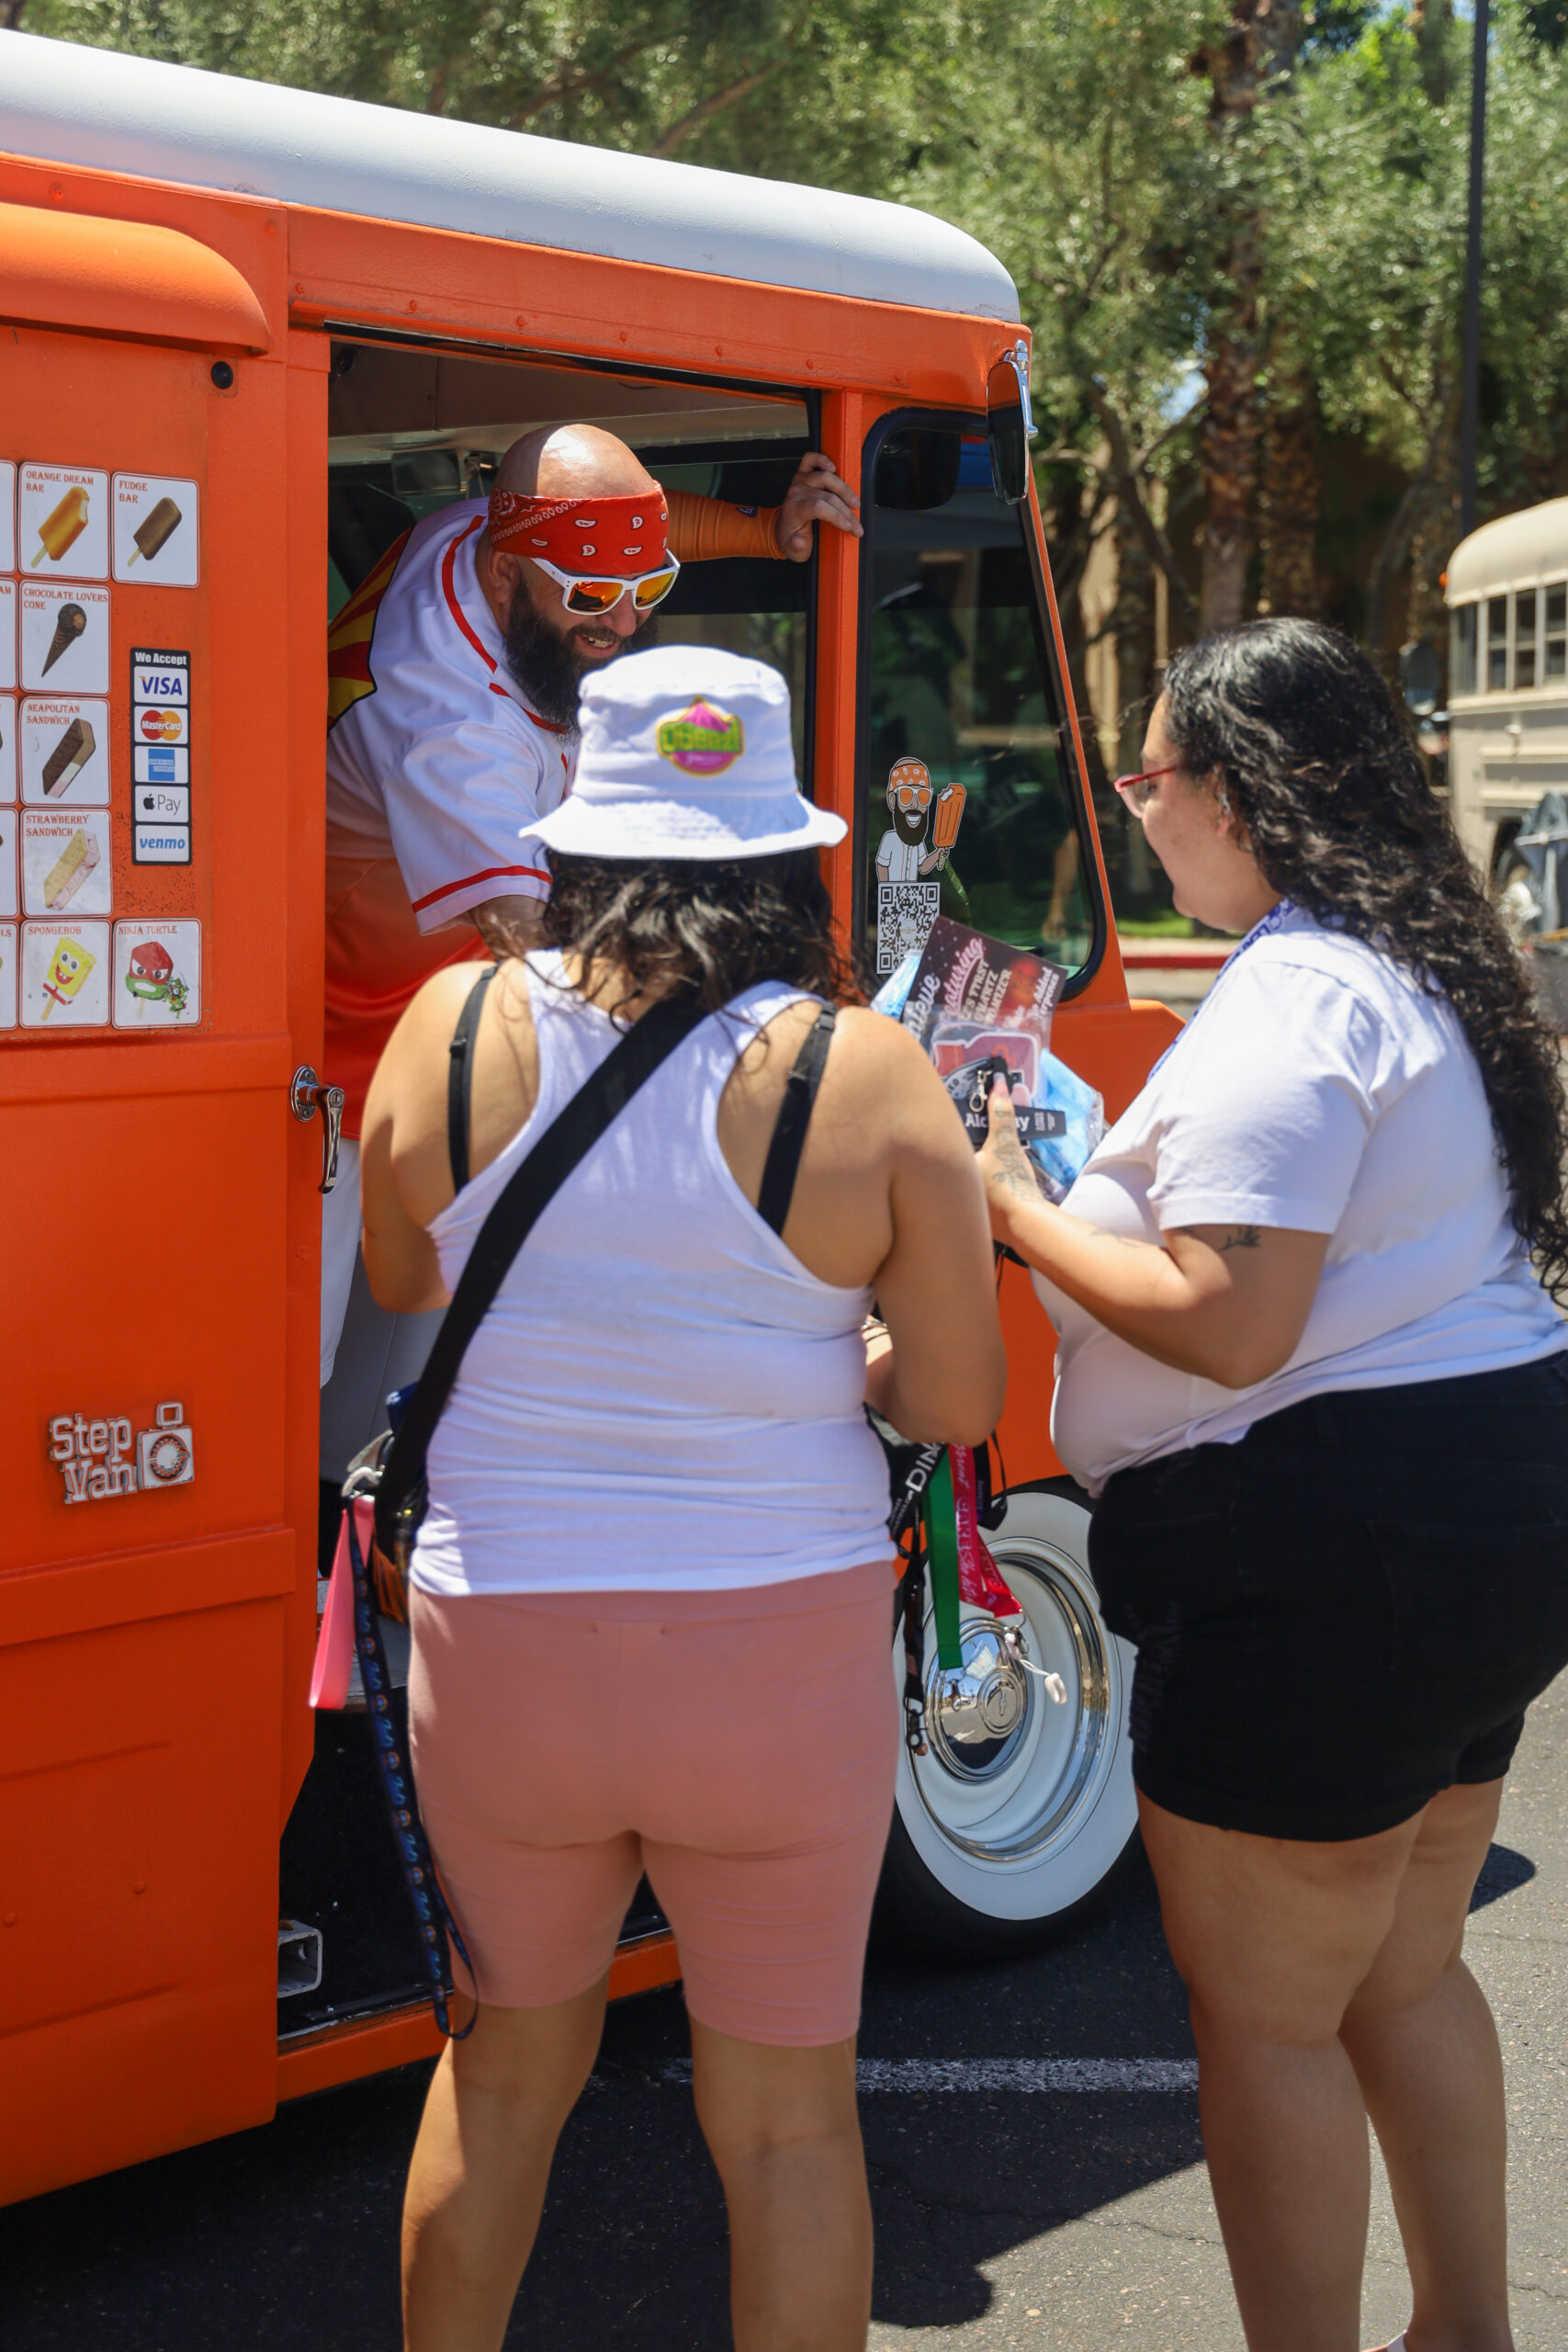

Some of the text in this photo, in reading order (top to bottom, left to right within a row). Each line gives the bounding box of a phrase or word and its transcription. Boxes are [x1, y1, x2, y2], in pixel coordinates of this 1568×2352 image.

[26, 469, 95, 486] ORANGE DREAM
[26, 482, 45, 493] BAR
[118, 480, 148, 492] FUDGE
[118, 492, 139, 504] BAR
[23, 587, 108, 604] CHOCOLATE LOVERS
[23, 600, 46, 611] CONE
[135, 651, 187, 666] We Accept
[140, 675, 183, 696] VISA
[27, 703, 81, 714] NEAPOLITAN
[26, 715, 71, 726] SANDWICH
[141, 719, 182, 731] MasterCard
[157, 795, 181, 816] Pay
[26, 814, 89, 825] STRAWBERRY
[26, 826, 73, 837] SANDWICH
[140, 836, 186, 850] venmo
[28, 925, 82, 935] SPONGEBOB
[118, 924, 177, 935] NINJA TURTLE
[49, 1411, 132, 1464] Step
[62, 1456, 138, 1505] Van
